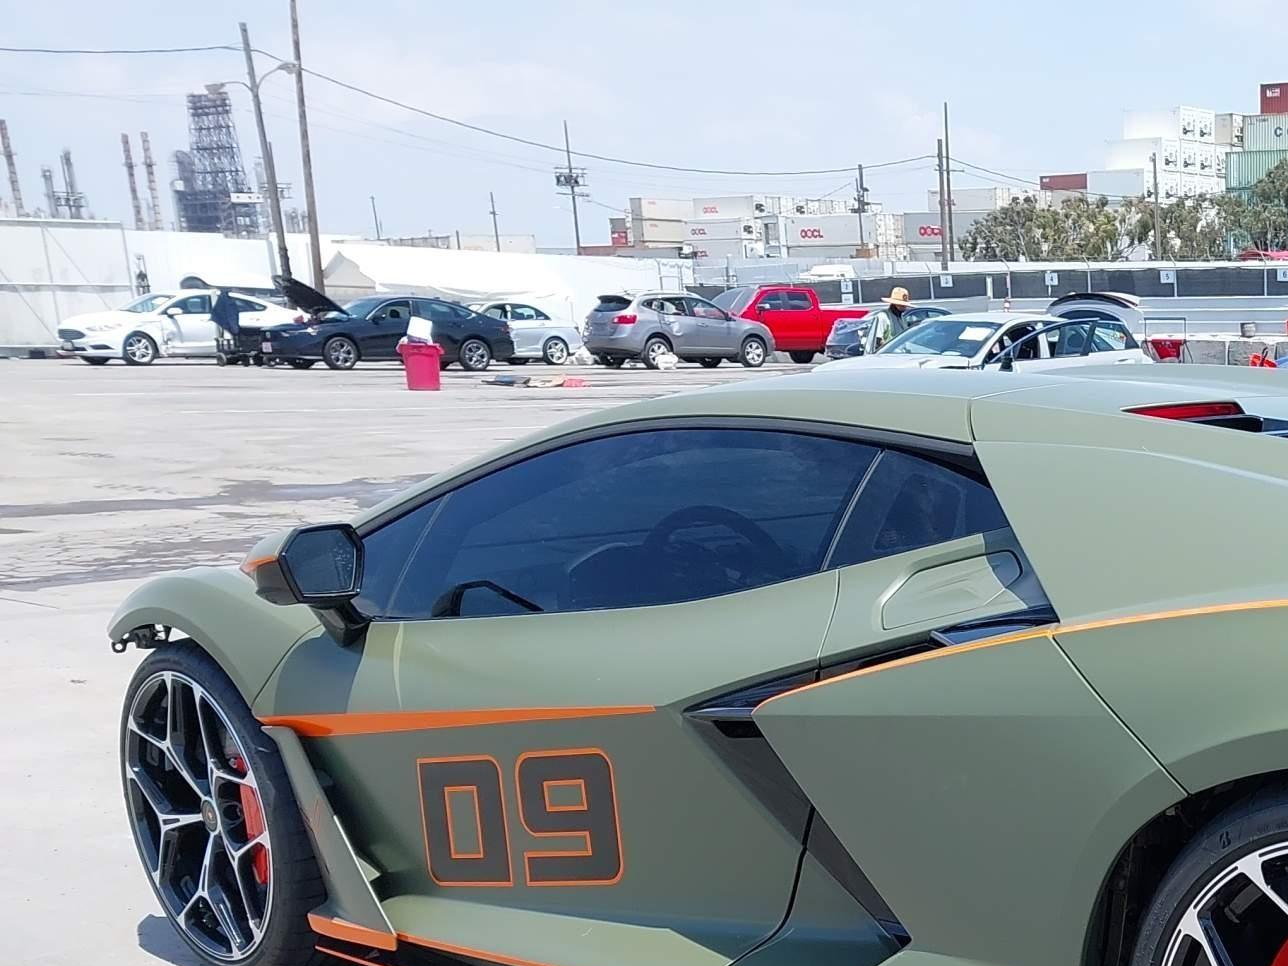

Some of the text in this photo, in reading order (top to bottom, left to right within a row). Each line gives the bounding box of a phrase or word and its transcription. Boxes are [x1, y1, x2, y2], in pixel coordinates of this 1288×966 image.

[800, 228, 824, 239] OOCL
[918, 225, 943, 237] OOC
[1282, 270, 1287, 280] 6
[416, 747, 624, 887] 09
